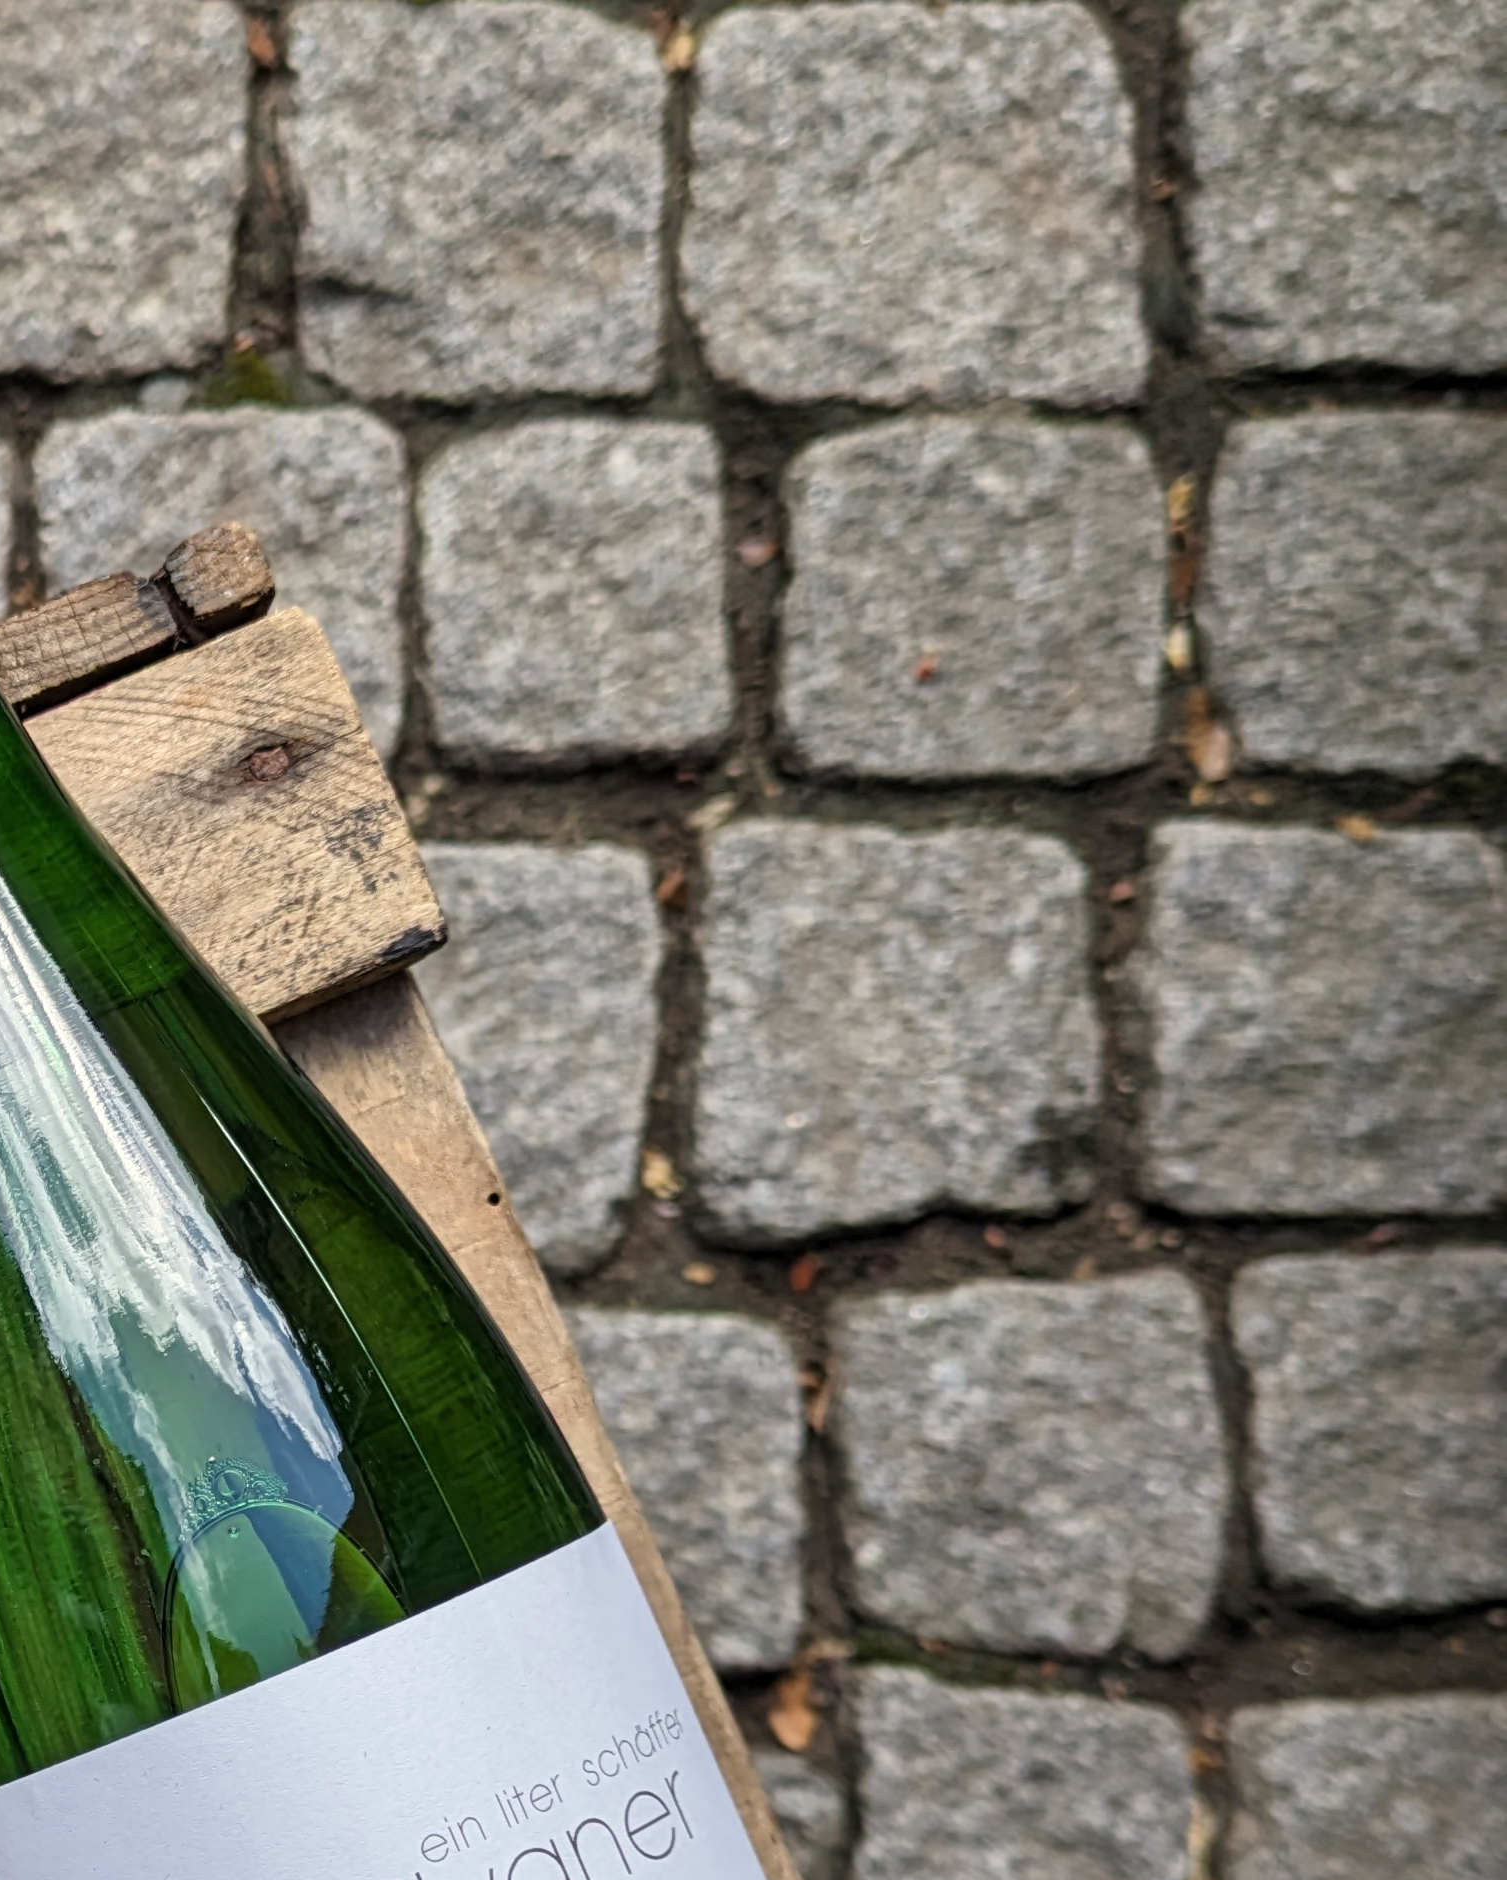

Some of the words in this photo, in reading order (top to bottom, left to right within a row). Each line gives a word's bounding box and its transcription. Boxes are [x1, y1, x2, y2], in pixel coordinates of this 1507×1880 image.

[420, 1816, 487, 1863] ein
[495, 1774, 563, 1828] liter
[582, 1709, 684, 1786] schäffer
